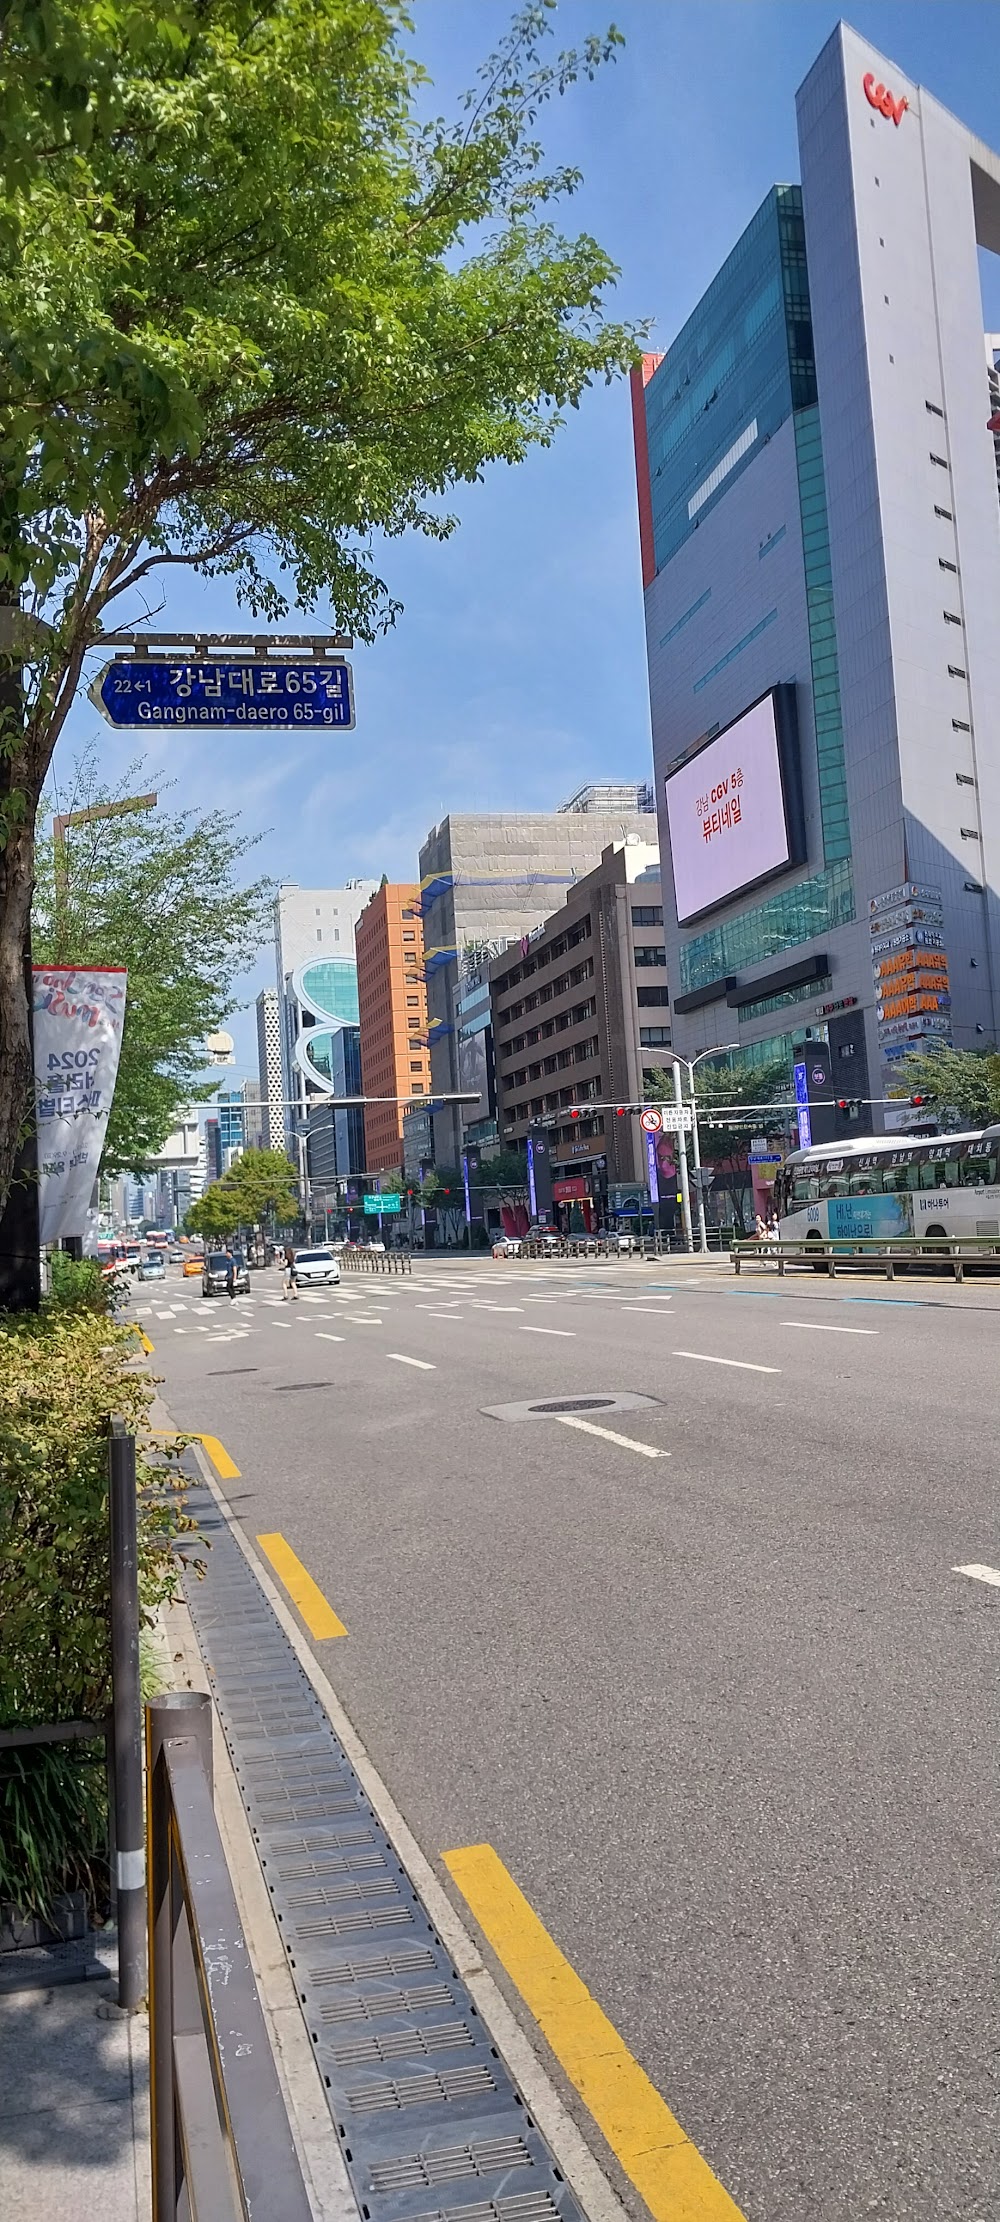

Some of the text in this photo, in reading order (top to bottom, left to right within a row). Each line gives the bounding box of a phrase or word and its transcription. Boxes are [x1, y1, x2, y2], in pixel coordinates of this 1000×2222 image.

[863, 72, 908, 128] CGV
[169, 668, 343, 699] 강남대로65길
[138, 702, 344, 723] Gangnam-daero 65-gil
[696, 768, 744, 816] 강남 CGV 5층
[702, 795, 742, 843] 뷰티네일
